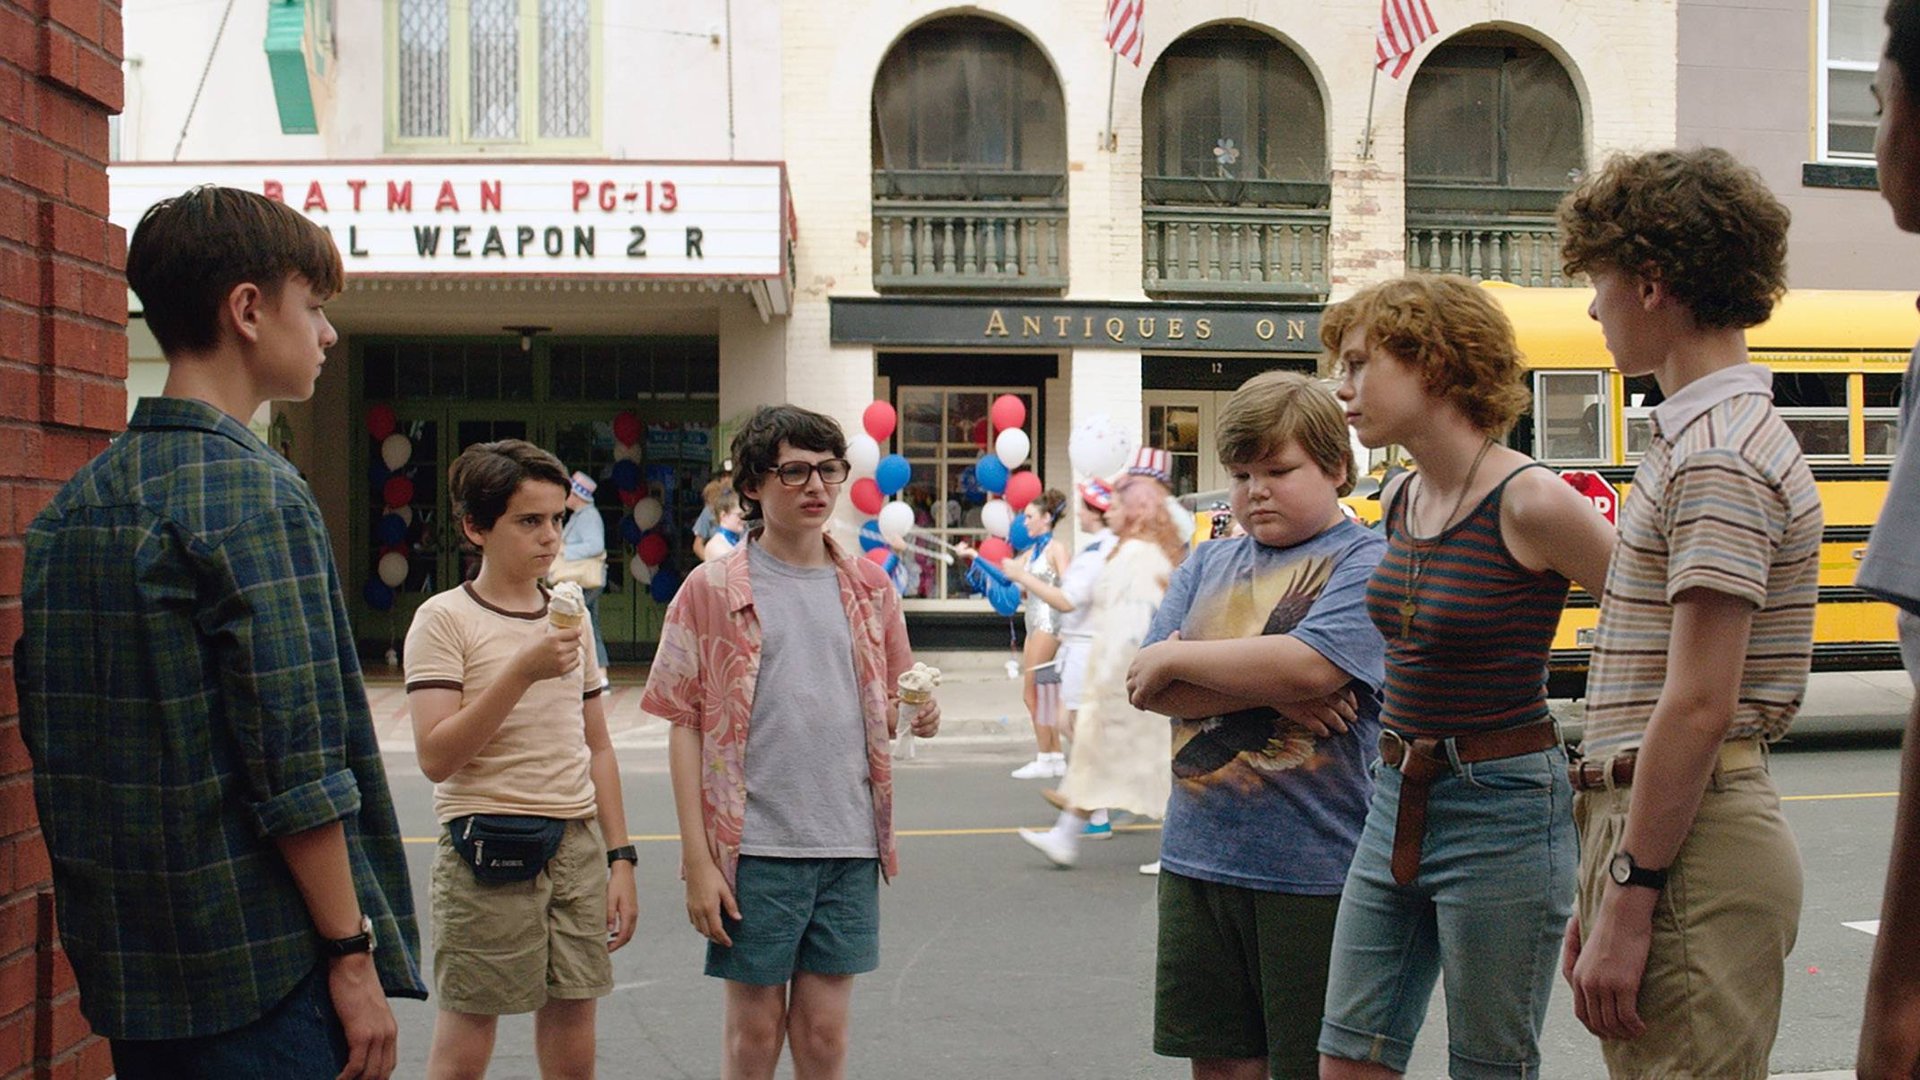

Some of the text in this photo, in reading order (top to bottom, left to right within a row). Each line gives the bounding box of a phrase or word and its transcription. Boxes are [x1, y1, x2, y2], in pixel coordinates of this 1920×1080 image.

[263, 179, 679, 213] BATMAN PG-13
[322, 225, 704, 258] L WEAPON 2 R
[984, 309, 1306, 342] ANTIQUES ON
[1211, 362, 1222, 374] 12
